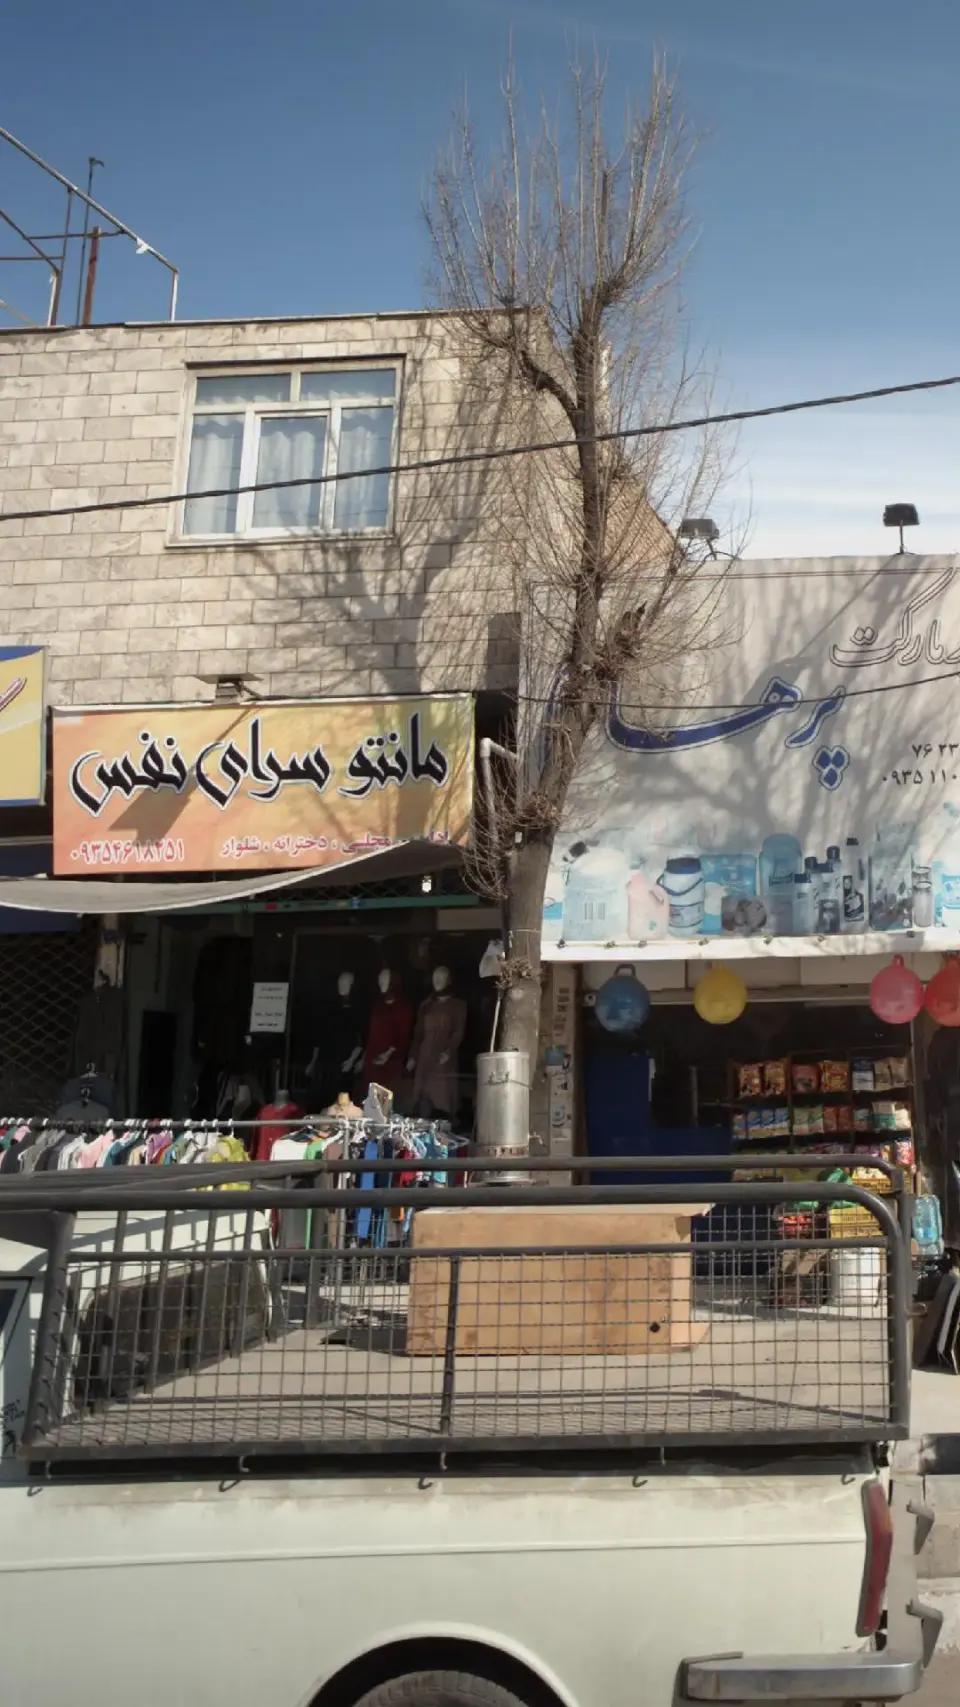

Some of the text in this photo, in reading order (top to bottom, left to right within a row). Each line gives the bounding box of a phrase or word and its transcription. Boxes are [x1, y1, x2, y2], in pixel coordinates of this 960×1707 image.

[70, 711, 449, 818] مانتو سرای نفس
[220, 834, 260, 858] شلوار
[273, 834, 328, 857] دخترانه
